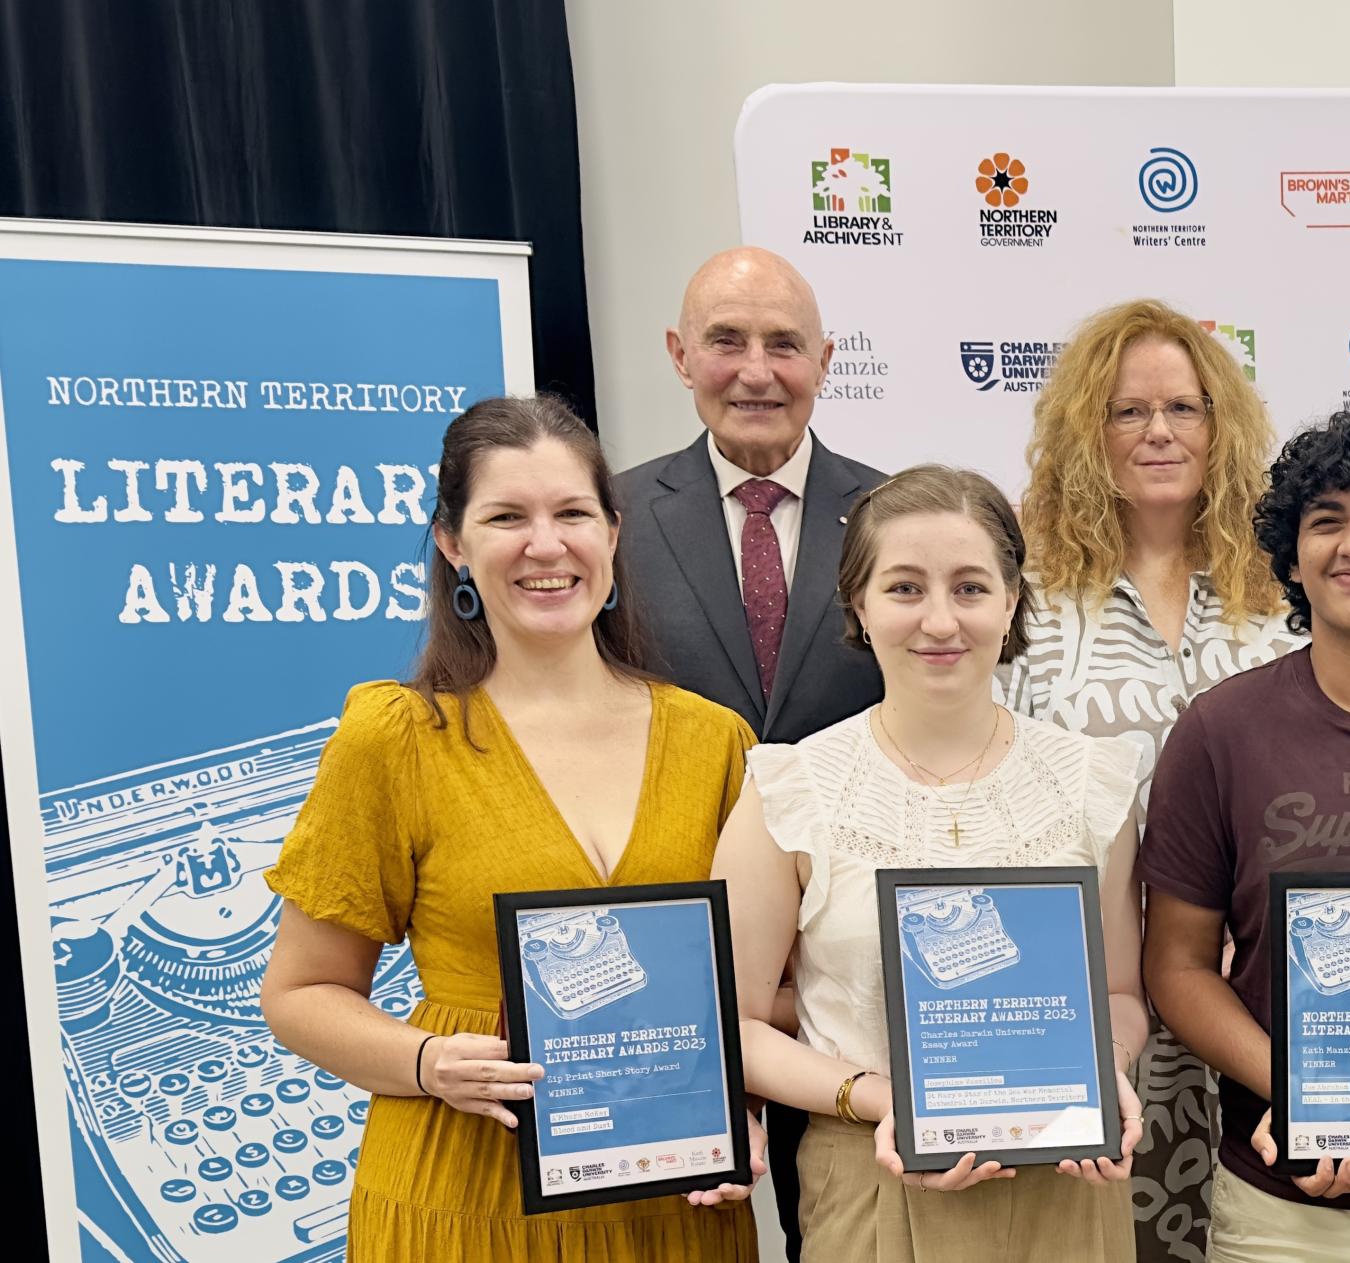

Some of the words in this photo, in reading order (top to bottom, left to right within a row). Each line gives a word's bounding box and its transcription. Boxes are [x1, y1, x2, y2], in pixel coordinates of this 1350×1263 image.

[1288, 178, 1350, 192] BROWN'S
[814, 216, 880, 230] LIBRARY
[882, 217, 892, 230] &
[980, 210, 1057, 224] NORTHERN
[980, 223, 1052, 238] TERRITORY
[1133, 225, 1169, 233] NORTHERN
[803, 231, 881, 245] ARCHIVES
[883, 233, 903, 245] NT
[981, 238, 1043, 246] GOVERNMENT
[1133, 235, 1171, 246] Writers'
[1174, 236, 1206, 246] Centre
[826, 355, 888, 375] anzie
[47, 377, 248, 408] NORTHERN
[262, 382, 466, 413] TERRITORY
[51, 457, 440, 524] LITERAR
[119, 562, 427, 624] AWARDS
[919, 999, 988, 1012] NORTHERN
[993, 996, 1068, 1009] TERRITORY
[920, 1011, 986, 1025] LITERARY
[991, 1010, 1040, 1022] AWARDS
[1044, 1009, 1077, 1022] 2023
[544, 1033, 616, 1050] NORTHERN
[622, 1025, 697, 1042] TERRITORY
[921, 1029, 958, 1039] Charles
[960, 1028, 993, 1038] Darwin
[996, 1026, 1046, 1038] University
[545, 1046, 615, 1064] LITERARY
[619, 1042, 669, 1057] AWARDS
[673, 1038, 706, 1051] 2023
[922, 1040, 948, 1050] Essay
[951, 1039, 978, 1048] Award
[1302, 1046, 1324, 1054] Kath
[922, 1056, 958, 1065] WINNER
[1303, 1060, 1336, 1068] WINNER
[547, 1075, 563, 1084] Zip
[566, 1073, 593, 1081] Print
[595, 1070, 622, 1078] Short
[625, 1066, 650, 1075] Story
[653, 1062, 680, 1072] Award
[548, 1087, 584, 1098] WINNER
